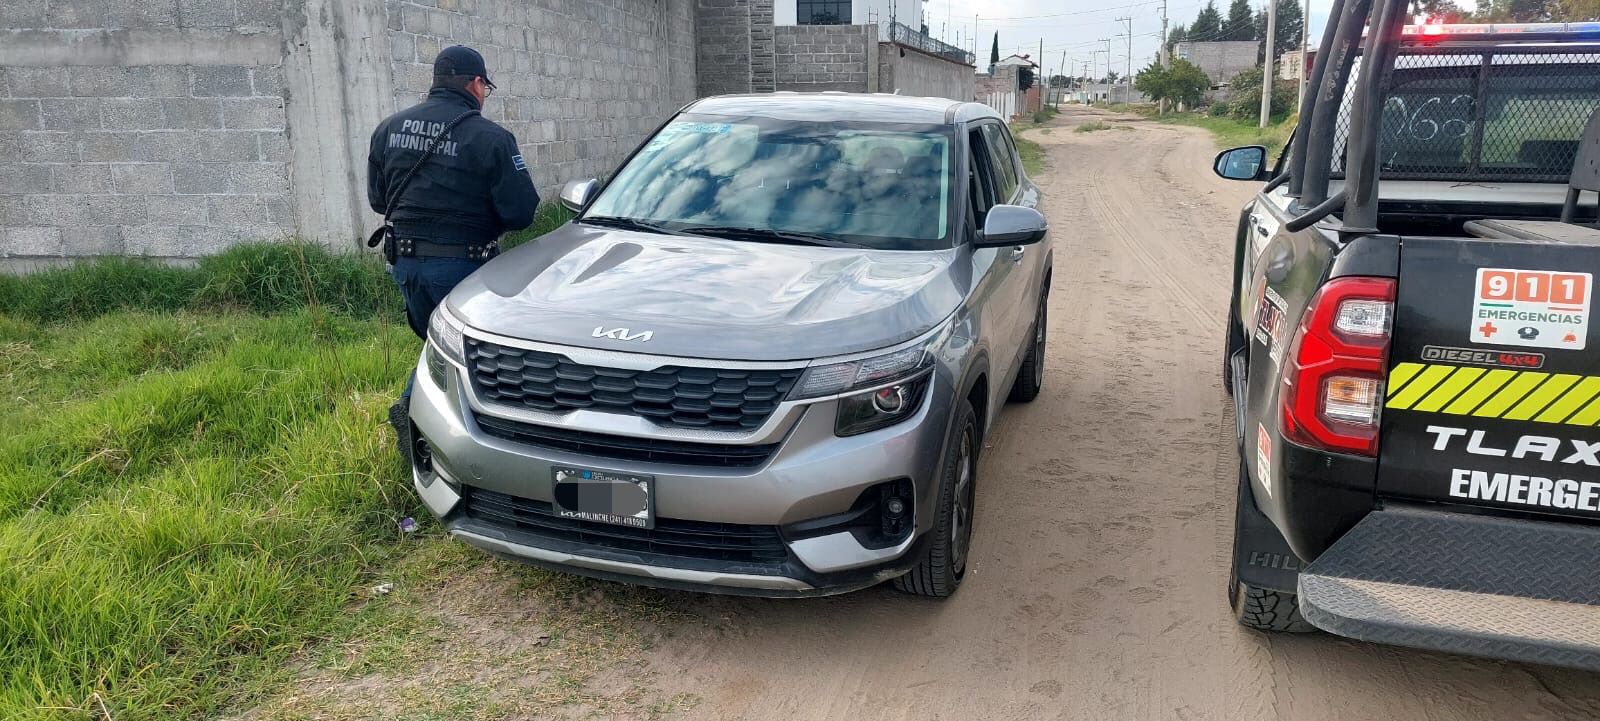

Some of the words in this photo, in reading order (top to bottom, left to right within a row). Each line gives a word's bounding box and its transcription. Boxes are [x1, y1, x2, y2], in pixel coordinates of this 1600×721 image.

[389, 133, 458, 157] MUNICPAL
[1488, 276, 1575, 300] 911
[1478, 309, 1582, 325] EMERGENCIAS
[591, 326, 654, 342] KIA
[1426, 348, 1497, 364] DIESEL
[1426, 425, 1600, 468] TLAX
[1450, 469, 1600, 512] EMERGE
